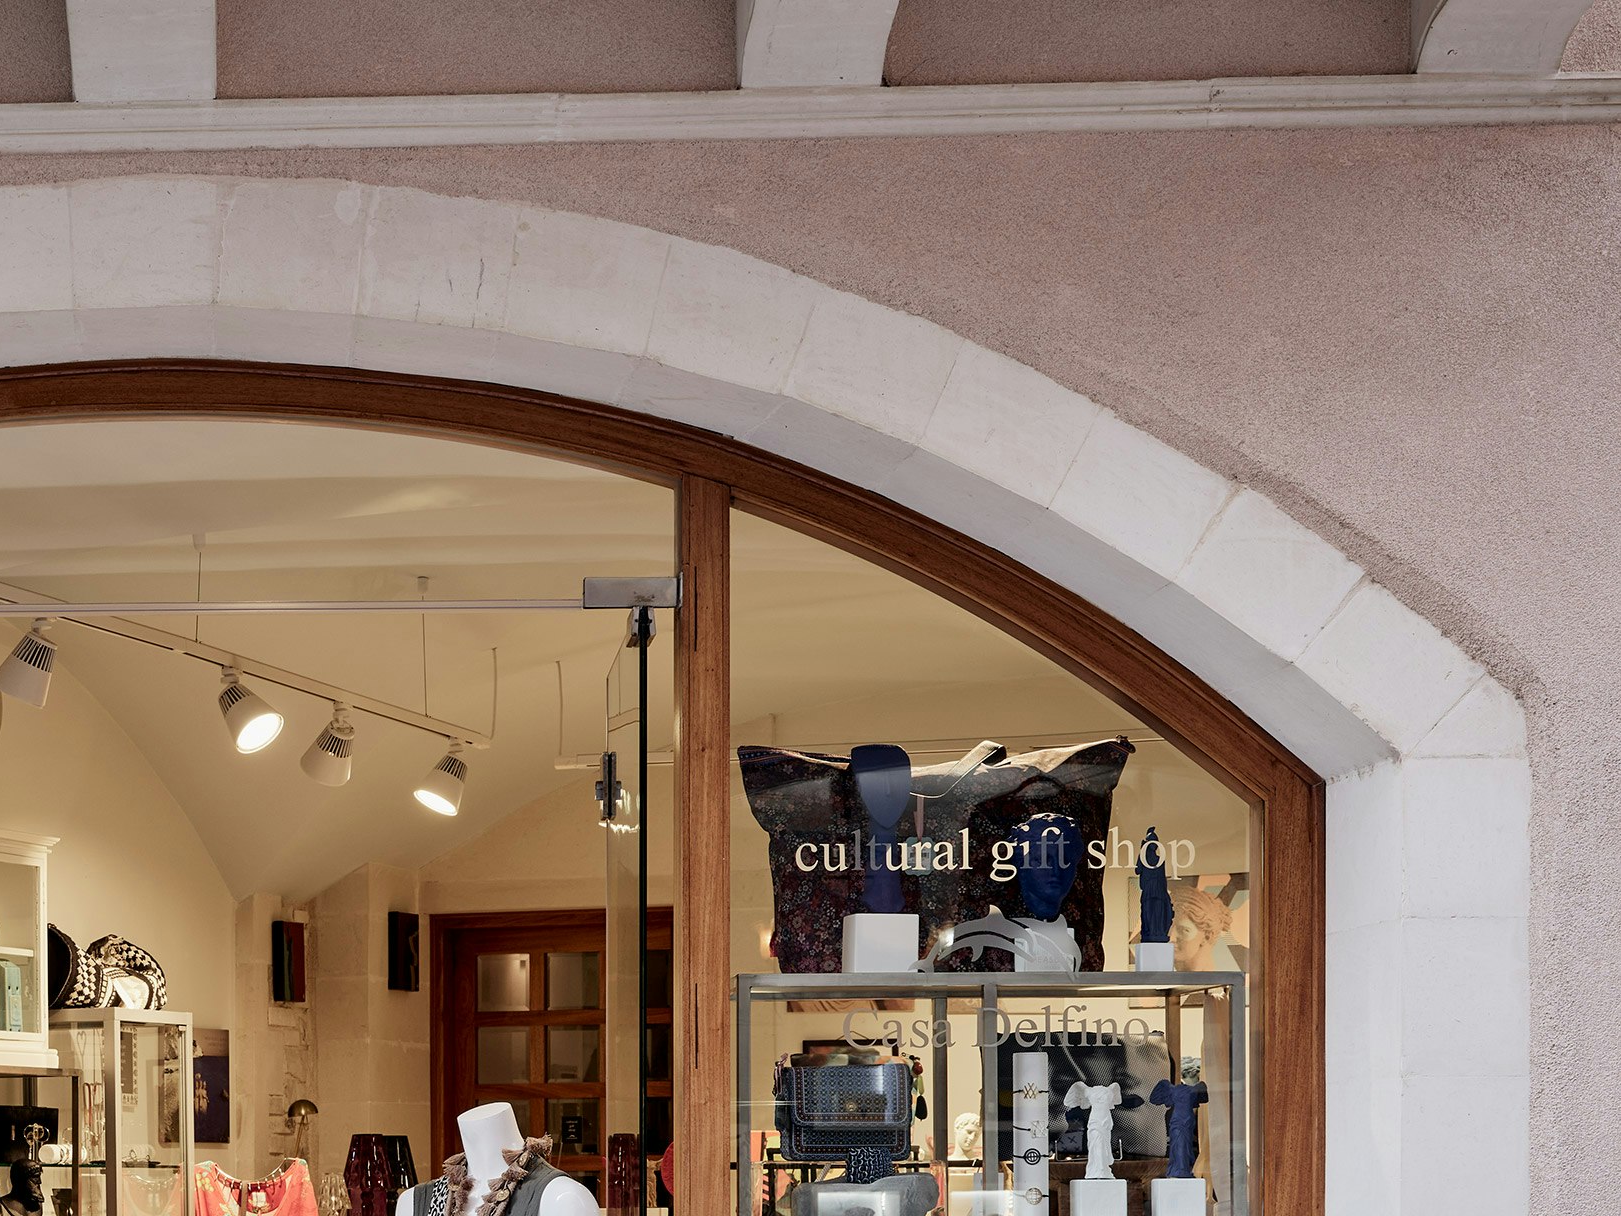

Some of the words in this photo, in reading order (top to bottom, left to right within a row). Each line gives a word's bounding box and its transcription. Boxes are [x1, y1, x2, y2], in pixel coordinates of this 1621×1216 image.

[794, 827, 974, 873] cultural
[989, 825, 1071, 882] gift
[1087, 826, 1197, 881] shop
[842, 1007, 956, 1050] Casa
[971, 1005, 1150, 1050] Delfino
